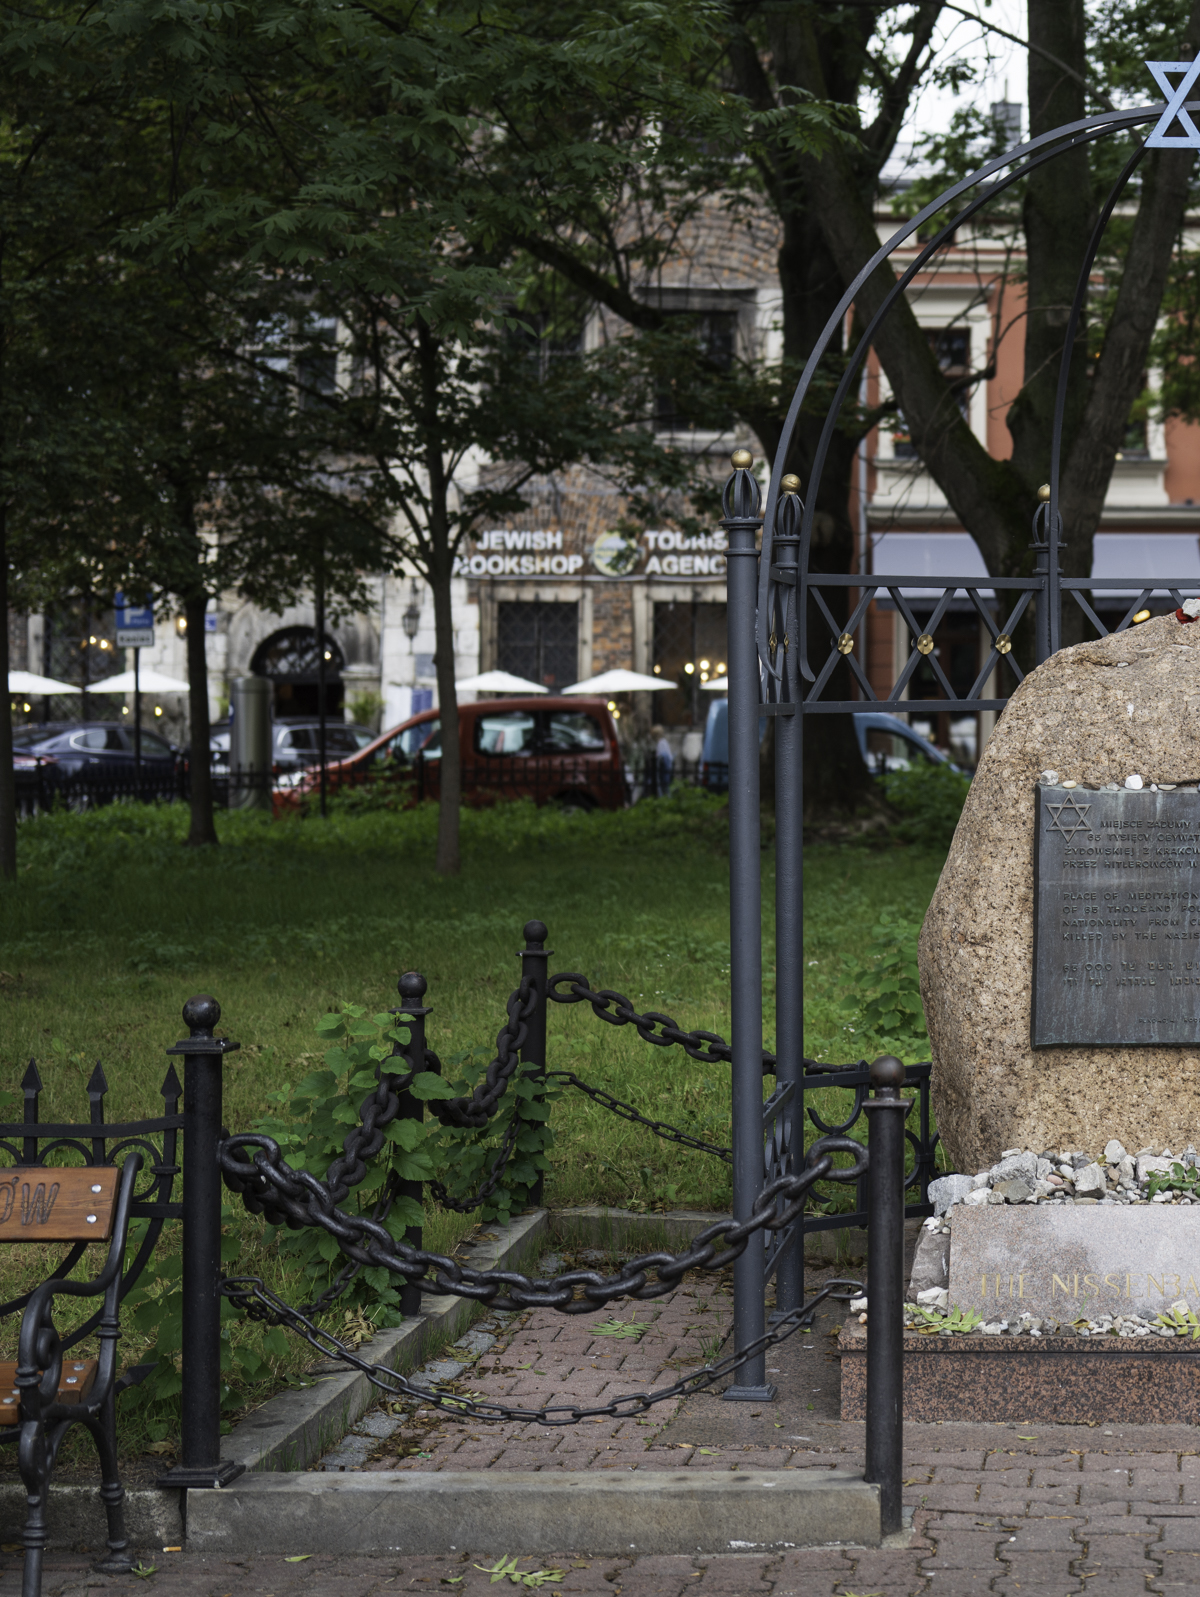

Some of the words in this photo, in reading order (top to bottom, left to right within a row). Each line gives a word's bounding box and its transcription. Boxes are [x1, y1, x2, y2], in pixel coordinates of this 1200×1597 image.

[476, 530, 563, 551] JEWISH
[1100, 820, 1143, 830] MIEJSCE
[1147, 820, 1190, 829] ZADUMY
[1087, 833, 1101, 842] 65
[1142, 847, 1150, 855] Z
[1063, 860, 1097, 869] PRZEZ
[1189, 860, 1198, 869] W
[1063, 892, 1097, 900] PLACE
[1104, 892, 1119, 900] OF
[1128, 891, 1199, 900] MEDITATION
[1062, 906, 1078, 914] OF
[1084, 906, 1098, 914] 65
[1107, 905, 1171, 913] THOUSAND
[1062, 919, 1137, 927] NATIONALITY
[1062, 932, 1103, 941] KILLED
[1112, 932, 1127, 940] BY
[1134, 932, 1157, 940] THE
[1165, 932, 1200, 940] NAZIS
[975, 1272, 1035, 1299] THE
